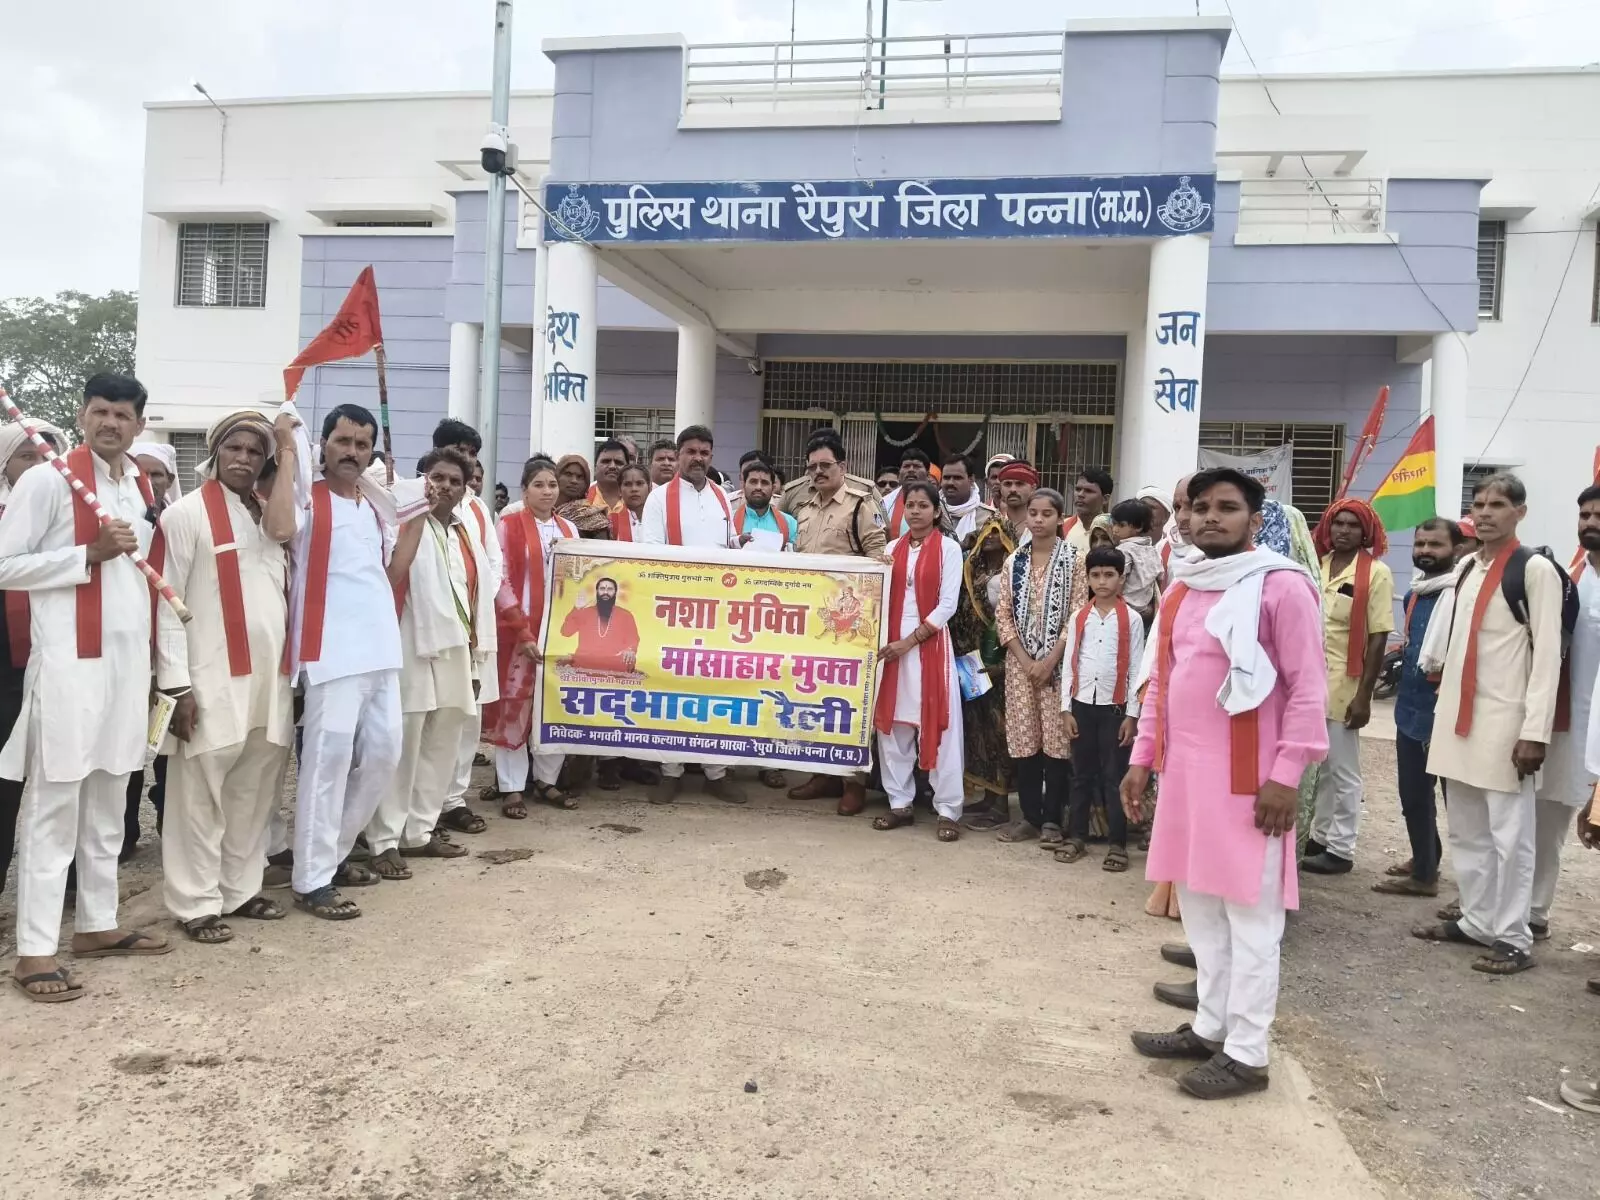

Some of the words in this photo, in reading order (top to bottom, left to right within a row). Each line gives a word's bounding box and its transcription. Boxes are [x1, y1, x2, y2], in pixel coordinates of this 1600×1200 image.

[602, 184, 695, 239] पुलिस
[700, 196, 786, 231] थाना
[792, 182, 885, 237] रैपुरा
[893, 180, 987, 231] जिला
[994, 191, 1093, 227] पन्ना
[547, 305, 580, 355] देश
[1156, 311, 1201, 348] जन
[544, 361, 588, 402] भक्ति
[1154, 367, 1199, 413] सेवा
[655, 595, 720, 629] नशा
[727, 593, 810, 643] मुक्ति
[660, 638, 785, 681] मांसाहार
[791, 656, 862, 693] मुक्त
[760, 690, 857, 733] रैली
[589, 730, 622, 742] भगवती
[624, 732, 650, 744] मानव
[651, 736, 686, 747] कल्याण
